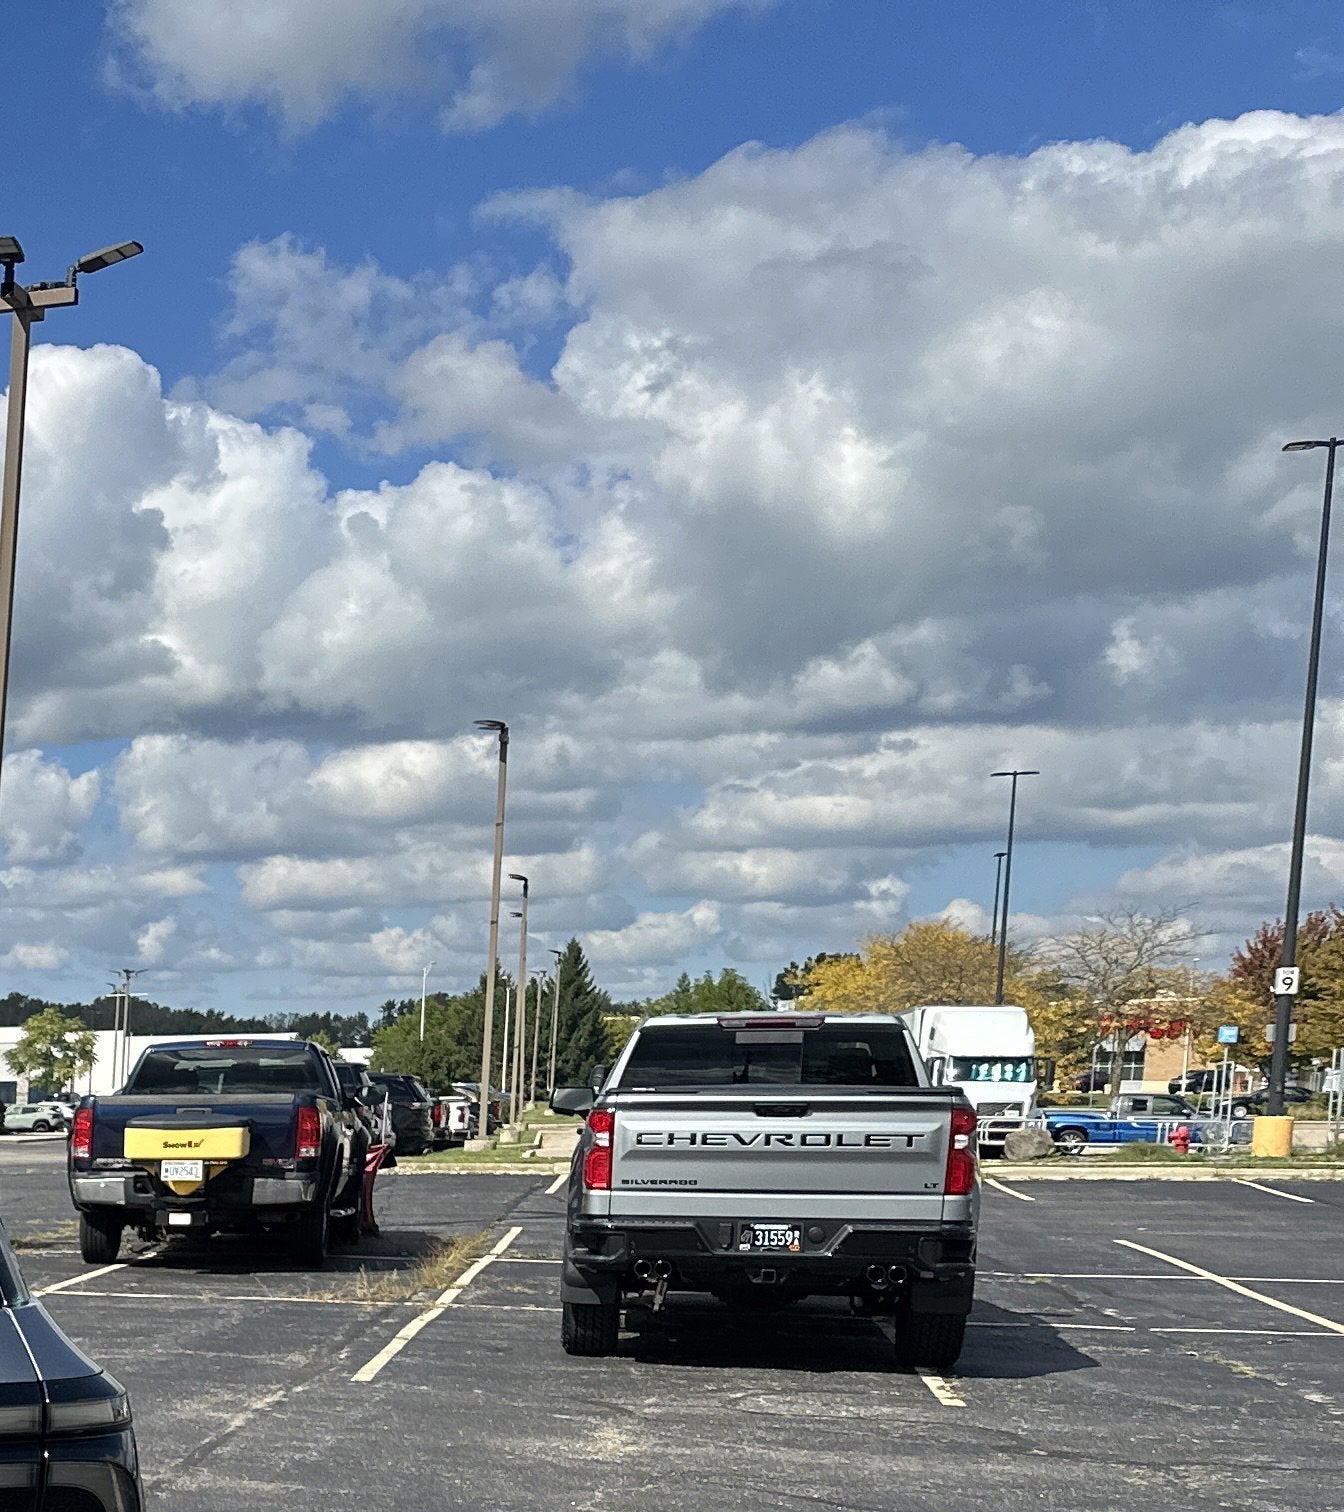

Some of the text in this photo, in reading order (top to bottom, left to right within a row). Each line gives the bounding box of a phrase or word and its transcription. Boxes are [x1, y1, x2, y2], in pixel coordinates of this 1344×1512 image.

[1282, 976, 1294, 992] 9
[635, 1132, 926, 1148] CHEVROLET
[754, 1229, 793, 1246] 31559
